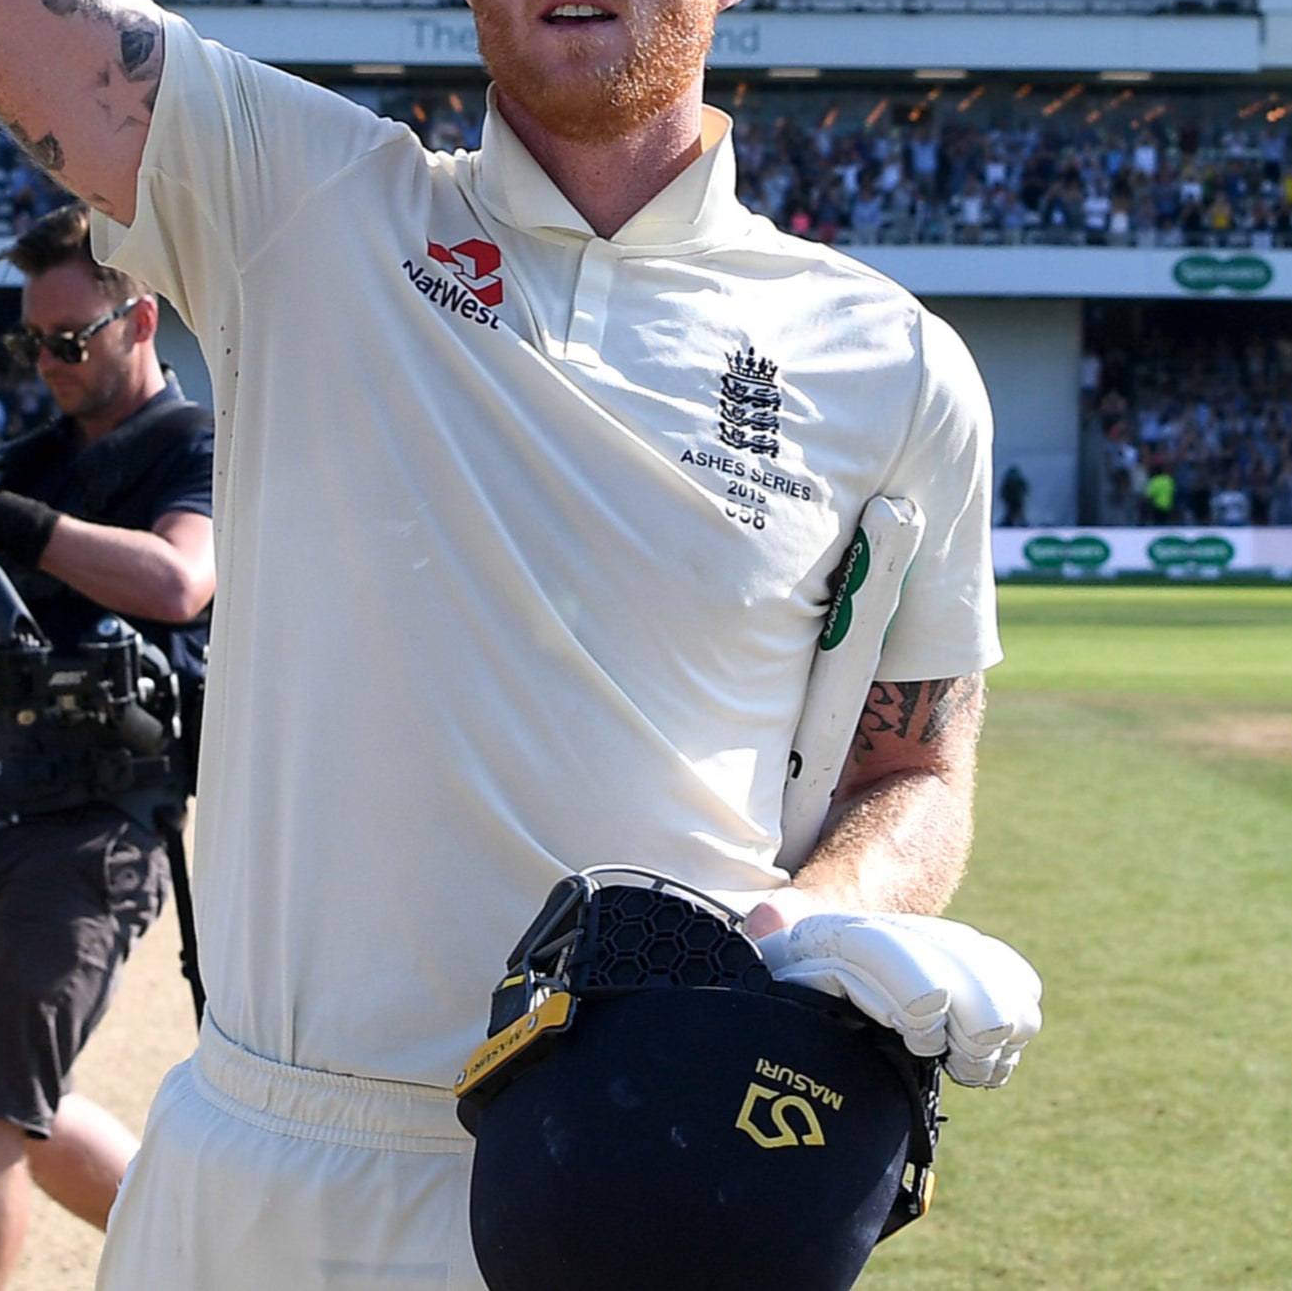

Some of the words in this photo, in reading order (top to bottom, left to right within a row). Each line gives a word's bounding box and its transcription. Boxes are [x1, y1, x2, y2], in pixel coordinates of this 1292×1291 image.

[402, 259, 500, 331] NatWest
[680, 448, 746, 477] ASHES
[749, 467, 811, 502] SERIES
[755, 1057, 844, 1111] MASURI
